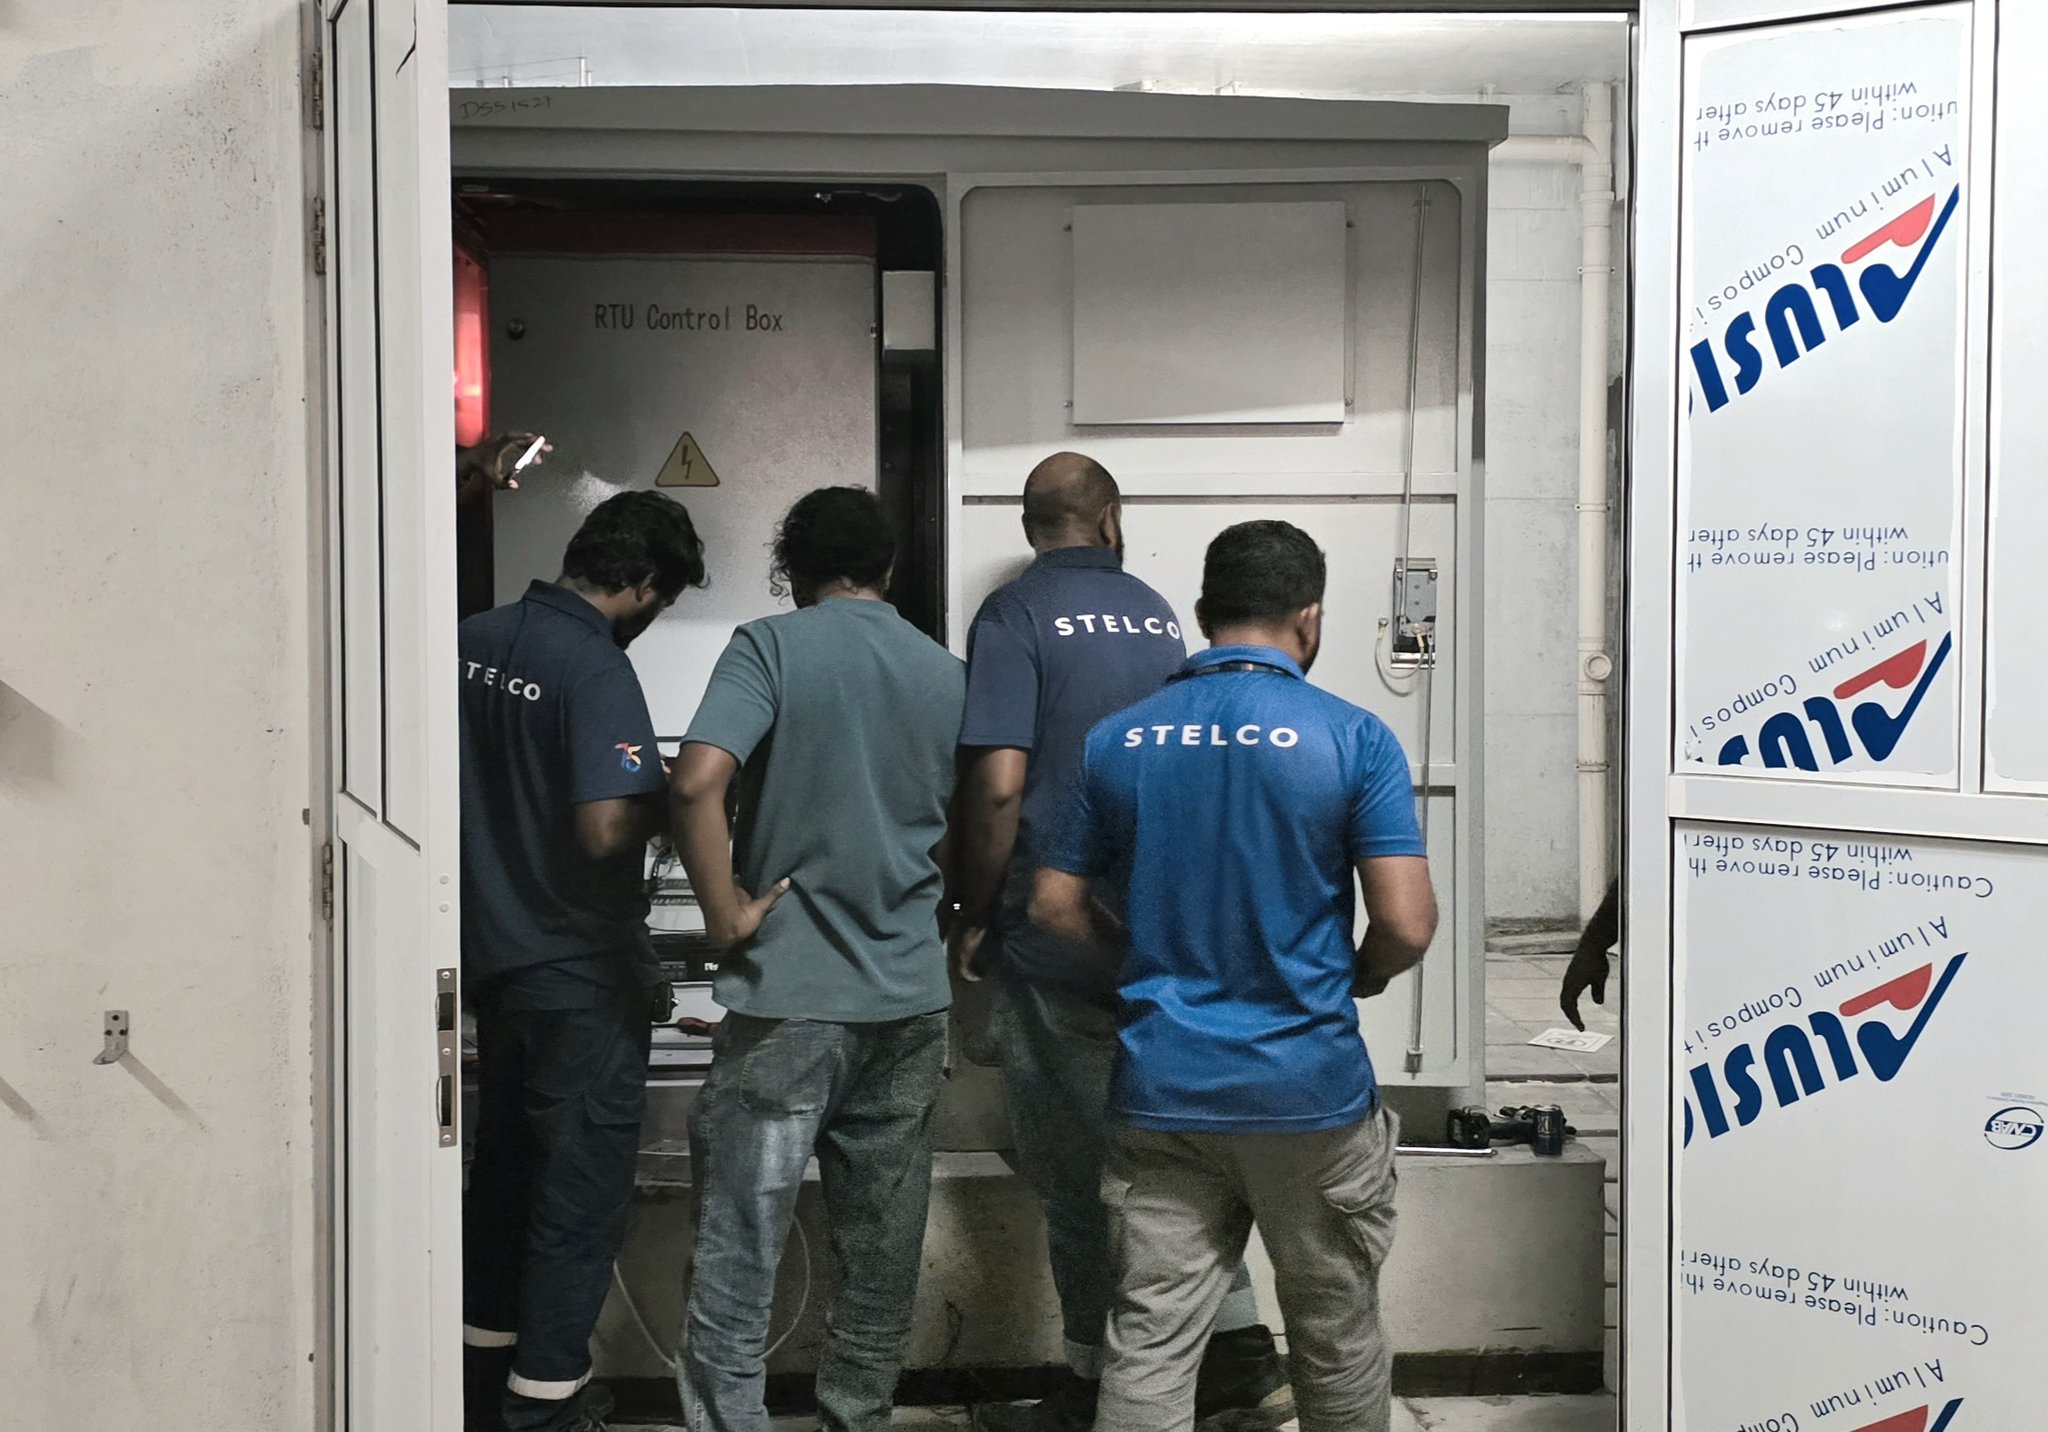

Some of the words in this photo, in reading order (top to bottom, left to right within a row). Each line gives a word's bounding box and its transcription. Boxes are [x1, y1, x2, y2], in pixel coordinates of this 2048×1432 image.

[1755, 92, 1806, 117] days
[1814, 91, 1843, 113] 45
[1852, 82, 1917, 107] within
[1696, 103, 1747, 126] after
[1812, 110, 1884, 133] Please
[1718, 120, 1802, 141] remove
[1815, 143, 1952, 240] Aluminum
[1690, 244, 1805, 326] Composi
[1689, 183, 1959, 420] ALUSI
[595, 304, 633, 329] RTU
[647, 303, 729, 331] Control
[746, 304, 783, 331] Box
[1688, 529, 1739, 550] after
[1748, 522, 1798, 549] days
[1807, 528, 1835, 547] 45
[1843, 527, 1908, 548] within
[1711, 552, 1794, 565] remove
[1804, 552, 1875, 573] Please
[1055, 614, 1181, 640] STELCO
[1808, 592, 1943, 673] Aluminum
[463, 660, 541, 701] TELCO
[1686, 674, 1798, 744] Composi
[1124, 724, 1299, 748] STELCO
[1693, 834, 1744, 857] after
[1752, 838, 1803, 861] days
[1811, 843, 1839, 862] 45
[1846, 844, 1912, 866] within
[1716, 860, 1799, 877] remove
[1808, 866, 1880, 891] Please
[1889, 871, 1993, 898] Caution:
[1814, 916, 1949, 988] Aluminum
[1749, 1258, 1800, 1288] days
[1808, 1272, 1836, 1293] 45
[1713, 1278, 1795, 1304] remove
[1844, 1277, 1909, 1301] within
[1804, 1294, 1876, 1326] Please
[1885, 1303, 1988, 1345] Caution:
[1810, 1359, 1944, 1419] Aluminum
